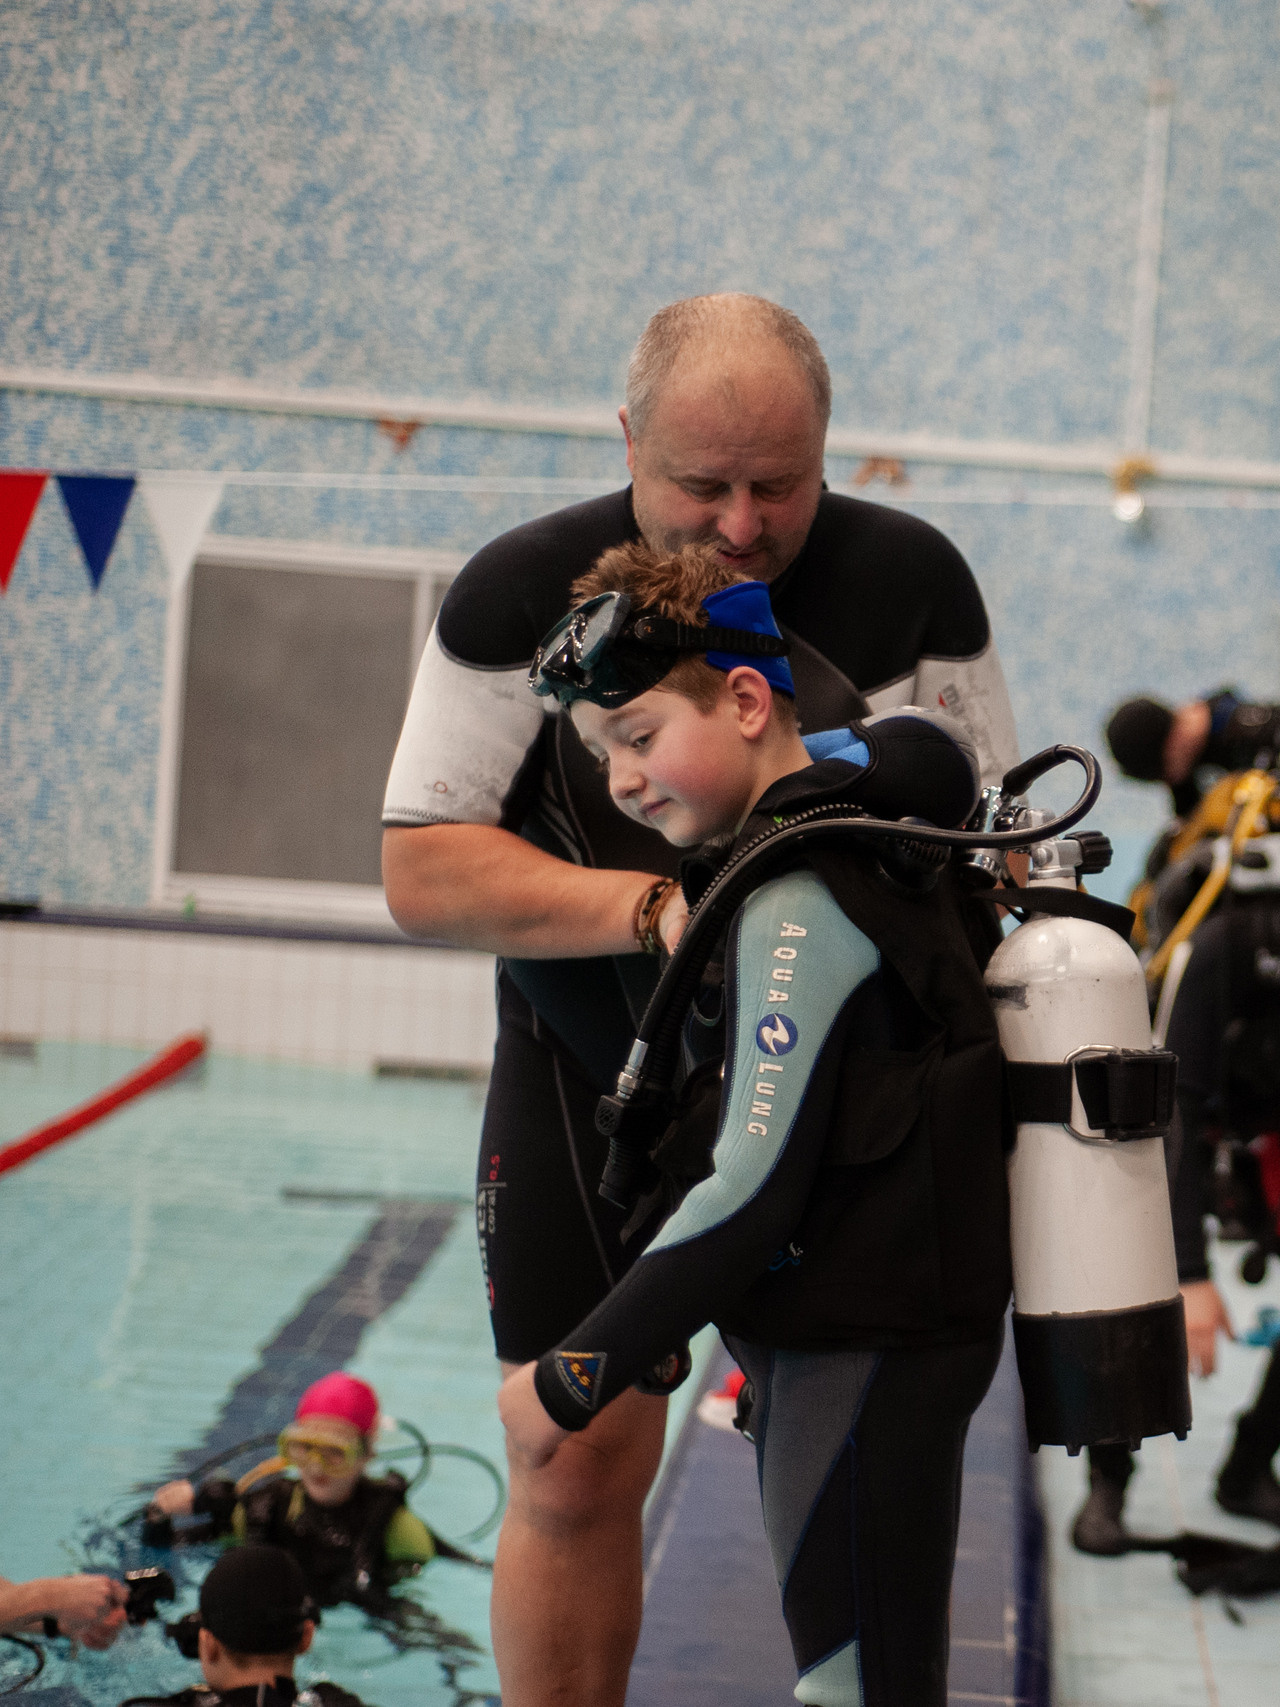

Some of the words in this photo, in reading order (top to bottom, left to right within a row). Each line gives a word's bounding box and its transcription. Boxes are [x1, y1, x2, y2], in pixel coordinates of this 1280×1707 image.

[767, 922, 808, 1004] AQUA
[747, 1062, 784, 1137] LUNG
[487, 1189, 496, 1233] coral
